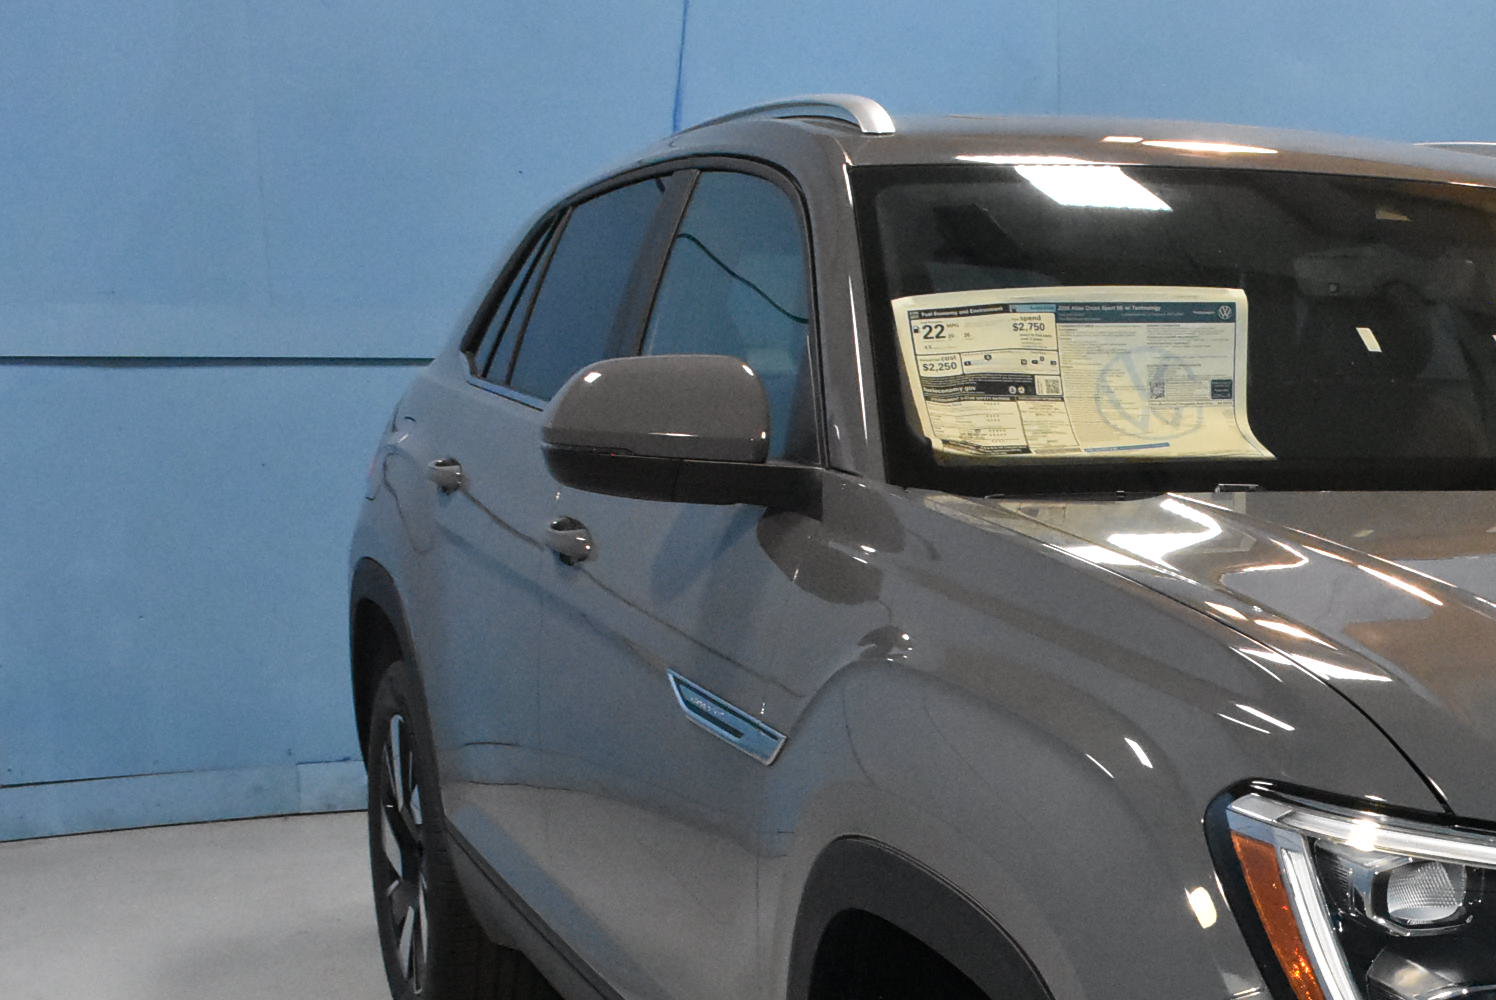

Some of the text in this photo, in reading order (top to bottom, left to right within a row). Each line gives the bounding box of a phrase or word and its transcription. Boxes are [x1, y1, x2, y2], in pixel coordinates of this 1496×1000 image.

[922, 324, 946, 339] 22
[1012, 322, 1045, 332] $2,750
[923, 362, 957, 372] $2,250
